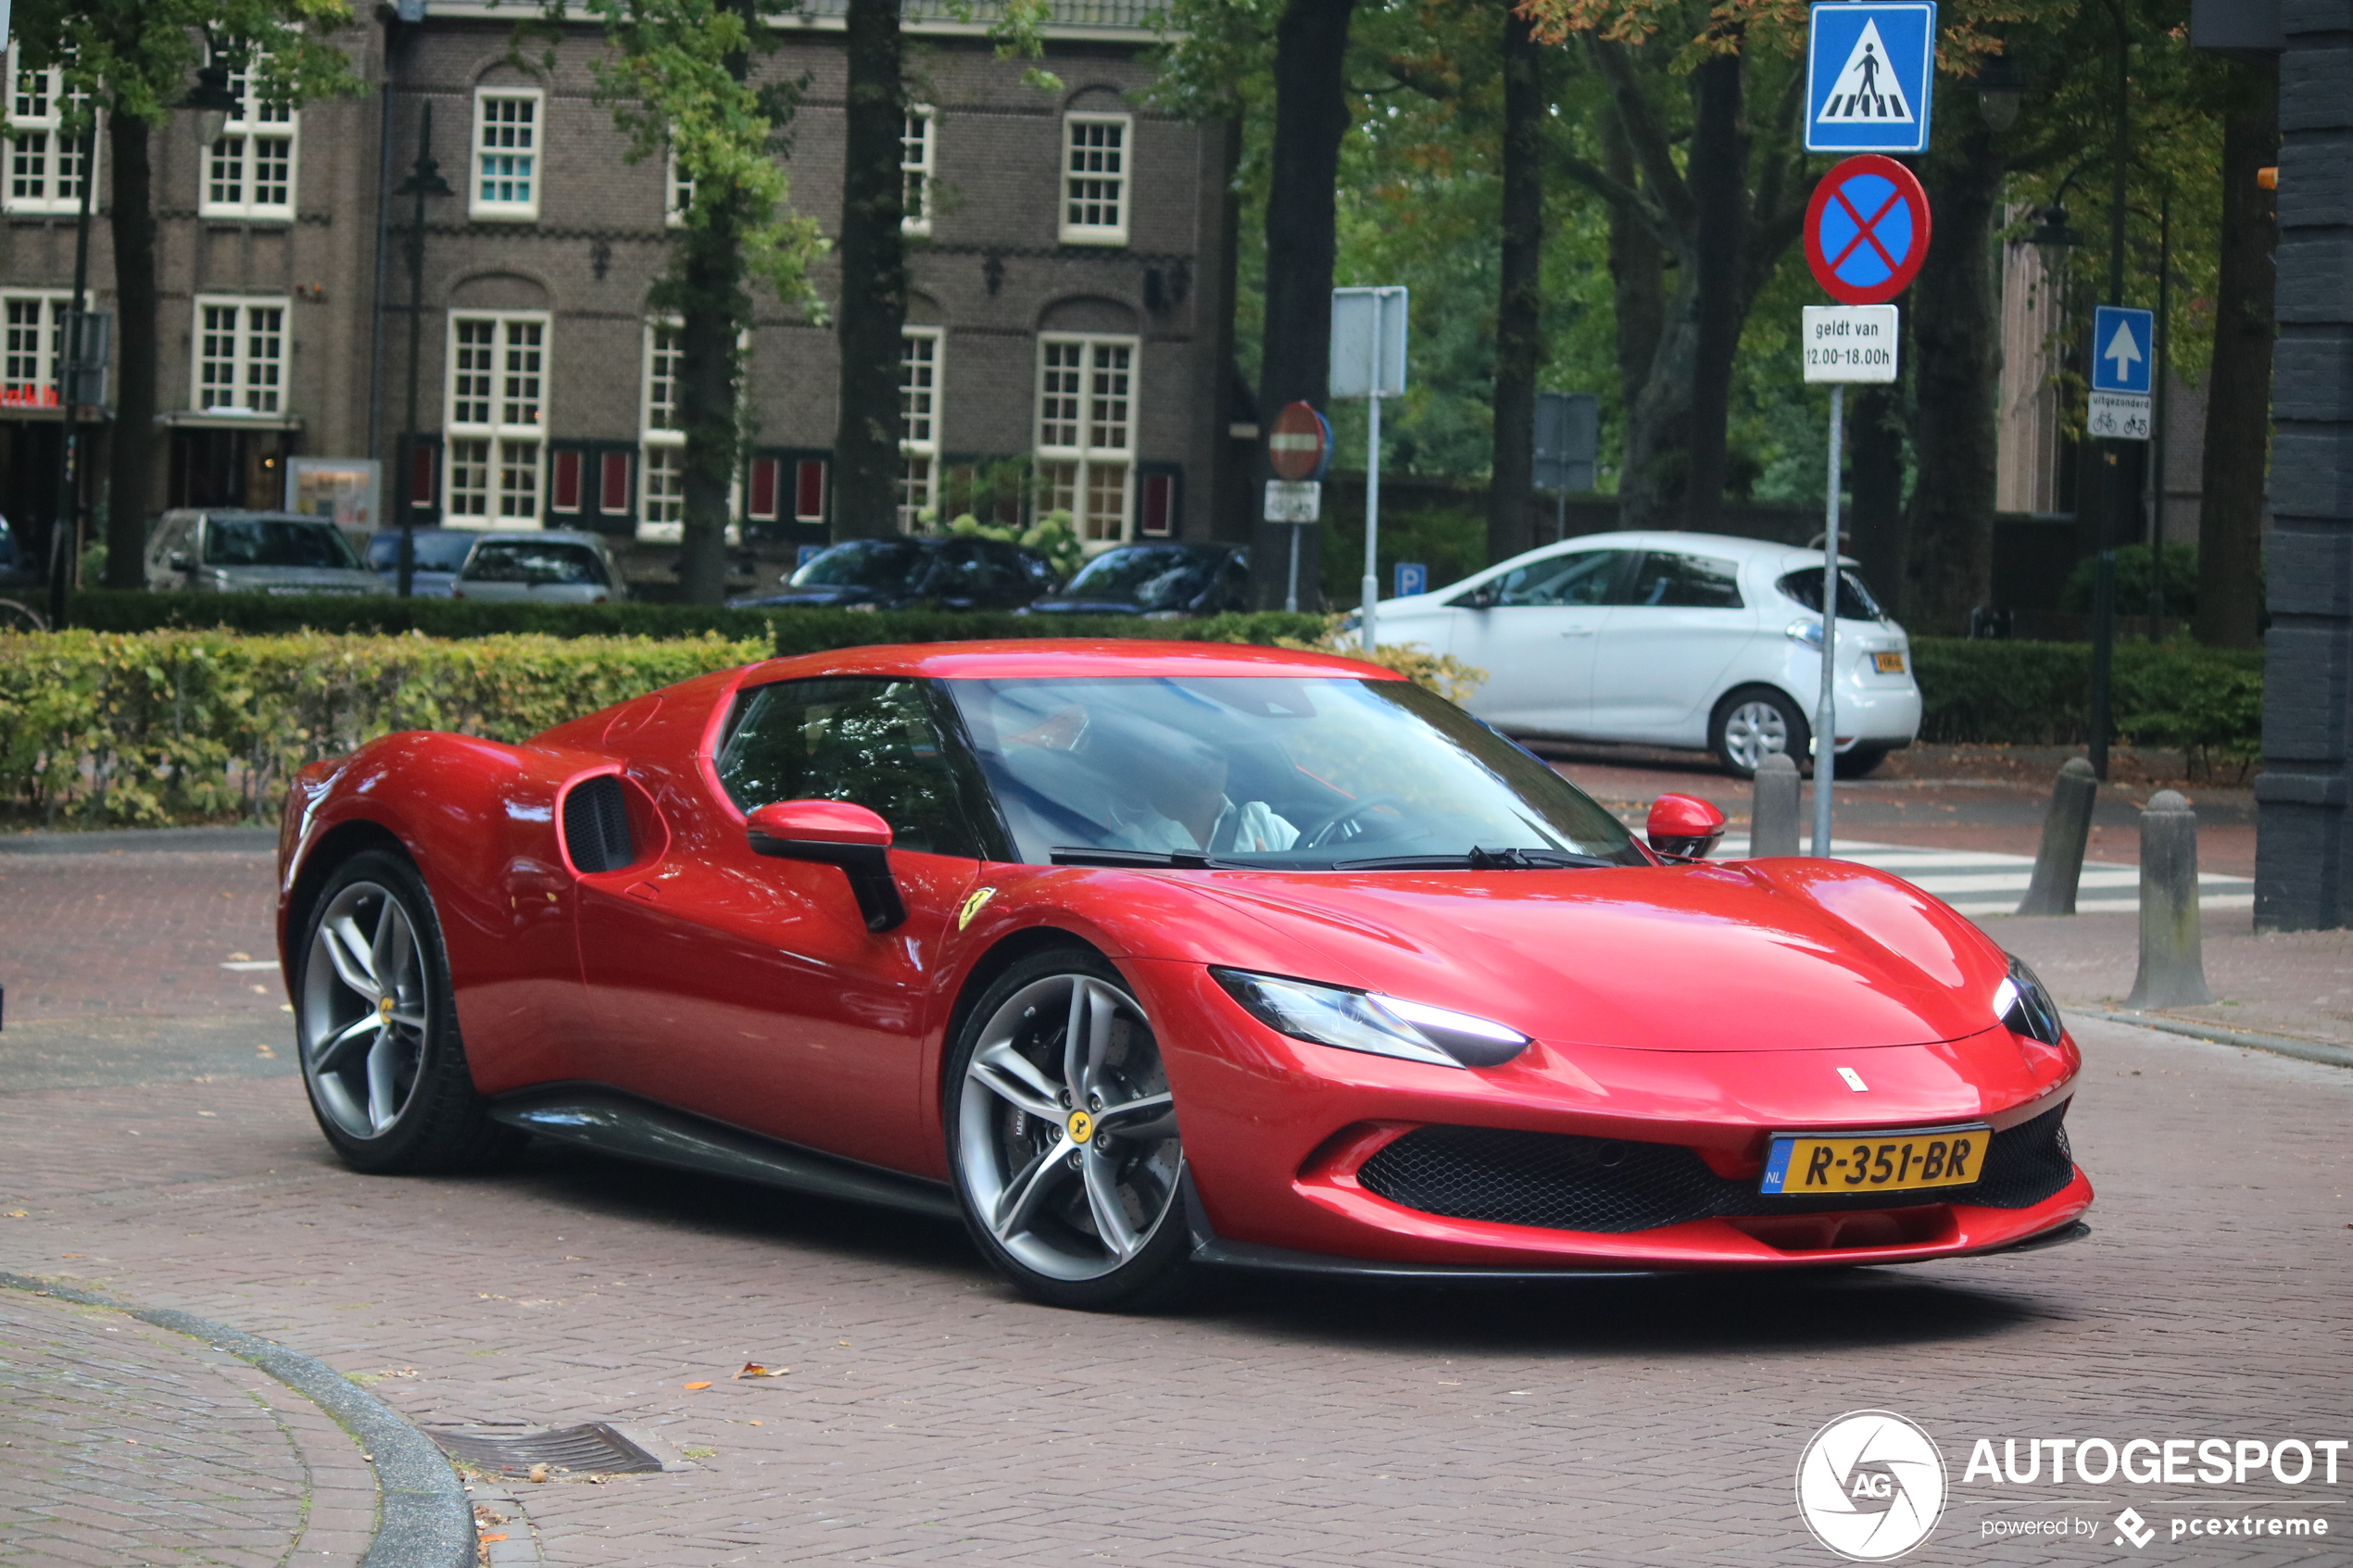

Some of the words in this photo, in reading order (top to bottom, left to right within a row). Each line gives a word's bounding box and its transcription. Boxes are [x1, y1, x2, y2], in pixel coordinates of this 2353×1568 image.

[1816, 320, 1850, 339] geldt
[1856, 323, 1879, 336] van
[2093, 395, 2150, 408] uitgezonderd
[1402, 569, 1419, 596] P
[1806, 1138, 1971, 1185] R-351-BR
[1765, 1171, 1781, 1185] NL
